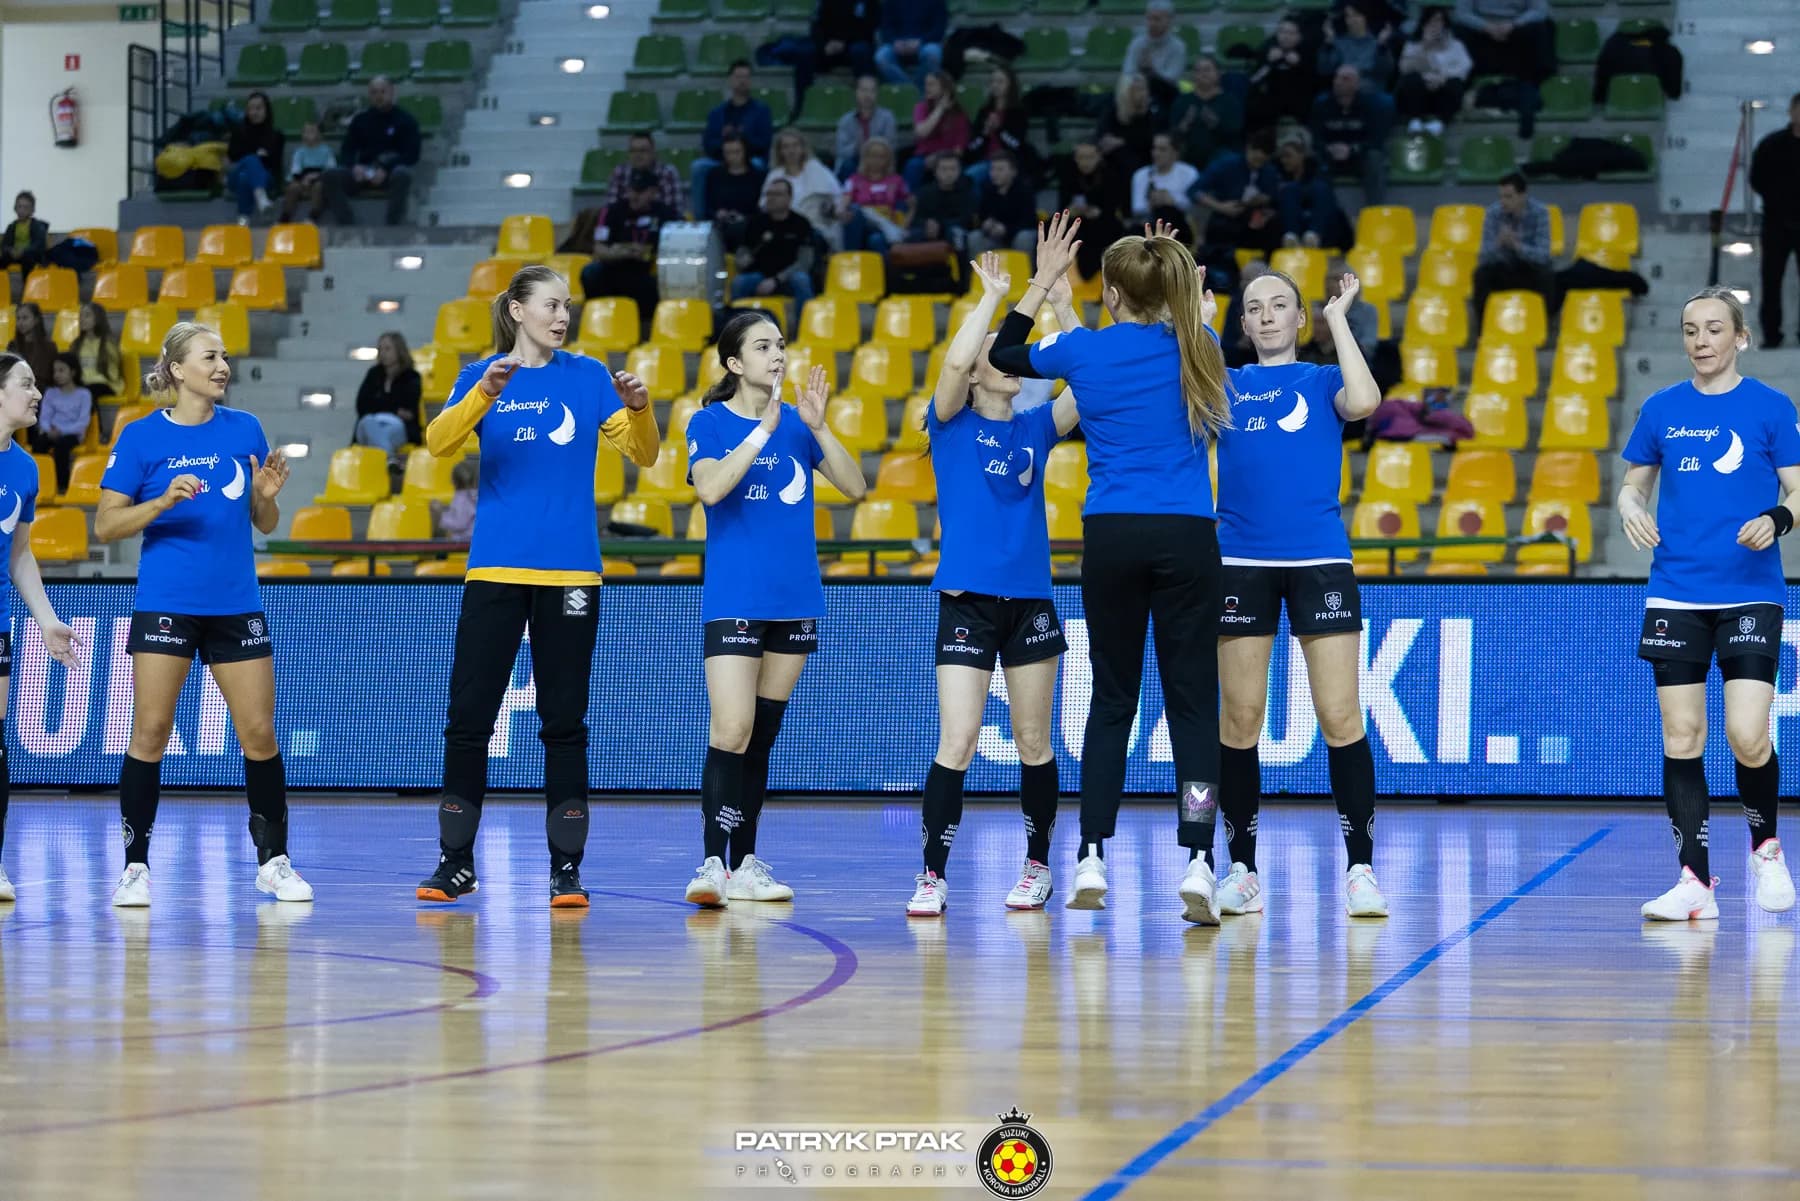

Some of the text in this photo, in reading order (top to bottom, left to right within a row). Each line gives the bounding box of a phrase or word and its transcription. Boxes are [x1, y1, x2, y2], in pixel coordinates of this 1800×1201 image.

[496, 397, 550, 414] Zobaczyć
[1244, 416, 1268, 432] Lili
[513, 426, 537, 442] Lili
[1665, 425, 1720, 442] Zobaczyć
[167, 453, 220, 470] Zobaczyć
[984, 459, 1009, 476] Lili
[1677, 456, 1701, 472] Lili
[744, 484, 770, 501] Lili
[1220, 615, 1251, 624] rabela
[1315, 610, 1352, 620] PROFIKA
[144, 632, 184, 646] karabela
[241, 635, 271, 647] PROFI
[722, 635, 758, 645] karabela
[789, 633, 818, 641] PROFI
[1025, 628, 1060, 646] PROFIKA
[1642, 637, 1681, 648] karabela
[1729, 634, 1767, 644] PROFIKA
[942, 643, 979, 655] karabela
